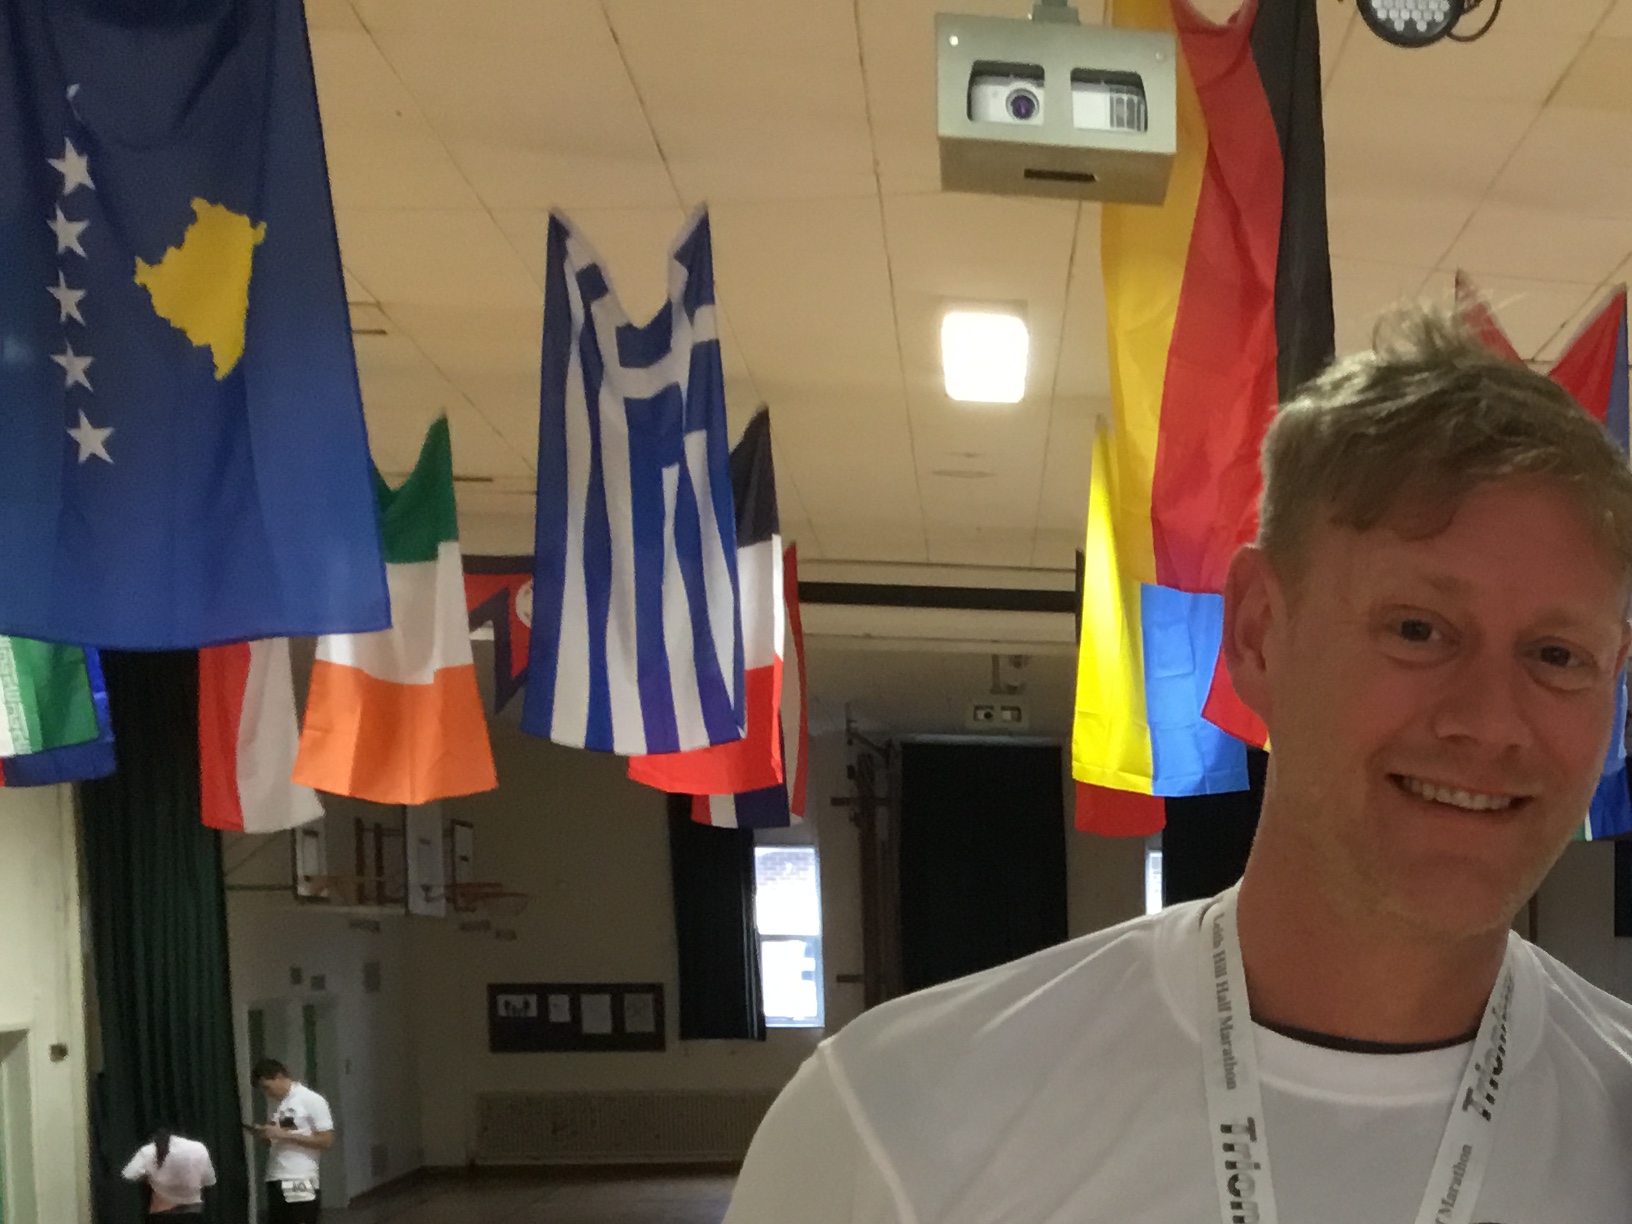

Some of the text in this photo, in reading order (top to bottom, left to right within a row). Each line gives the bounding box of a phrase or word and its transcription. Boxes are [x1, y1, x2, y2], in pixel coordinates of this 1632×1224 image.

[1213, 950, 1228, 979] Hill
[1216, 980, 1233, 1013] Half
[1219, 1015, 1239, 1091] Marathon
[1437, 1144, 1474, 1219] Marathon
